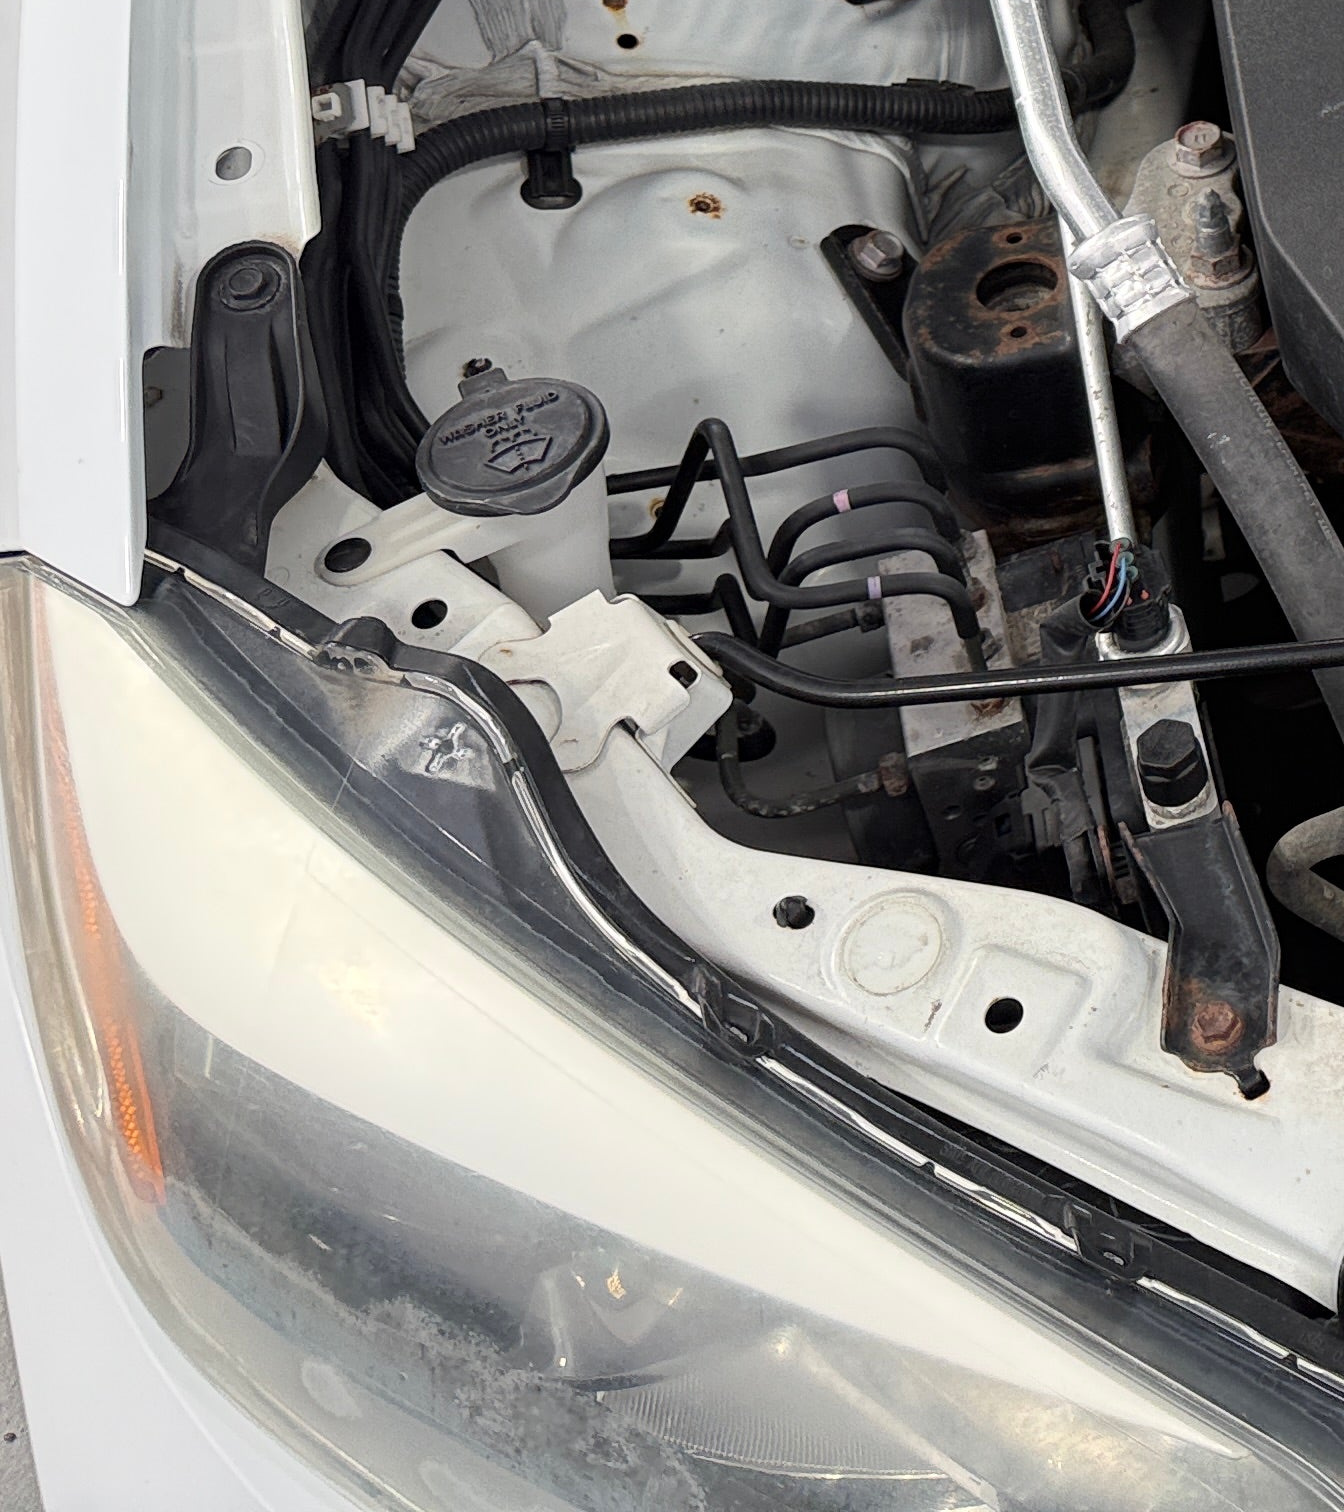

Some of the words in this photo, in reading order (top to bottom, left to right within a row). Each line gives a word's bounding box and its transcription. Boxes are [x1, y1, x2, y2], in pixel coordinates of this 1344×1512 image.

[439, 410, 508, 446] WASHER
[513, 391, 560, 415] FLUID
[484, 414, 527, 439] ONLY
